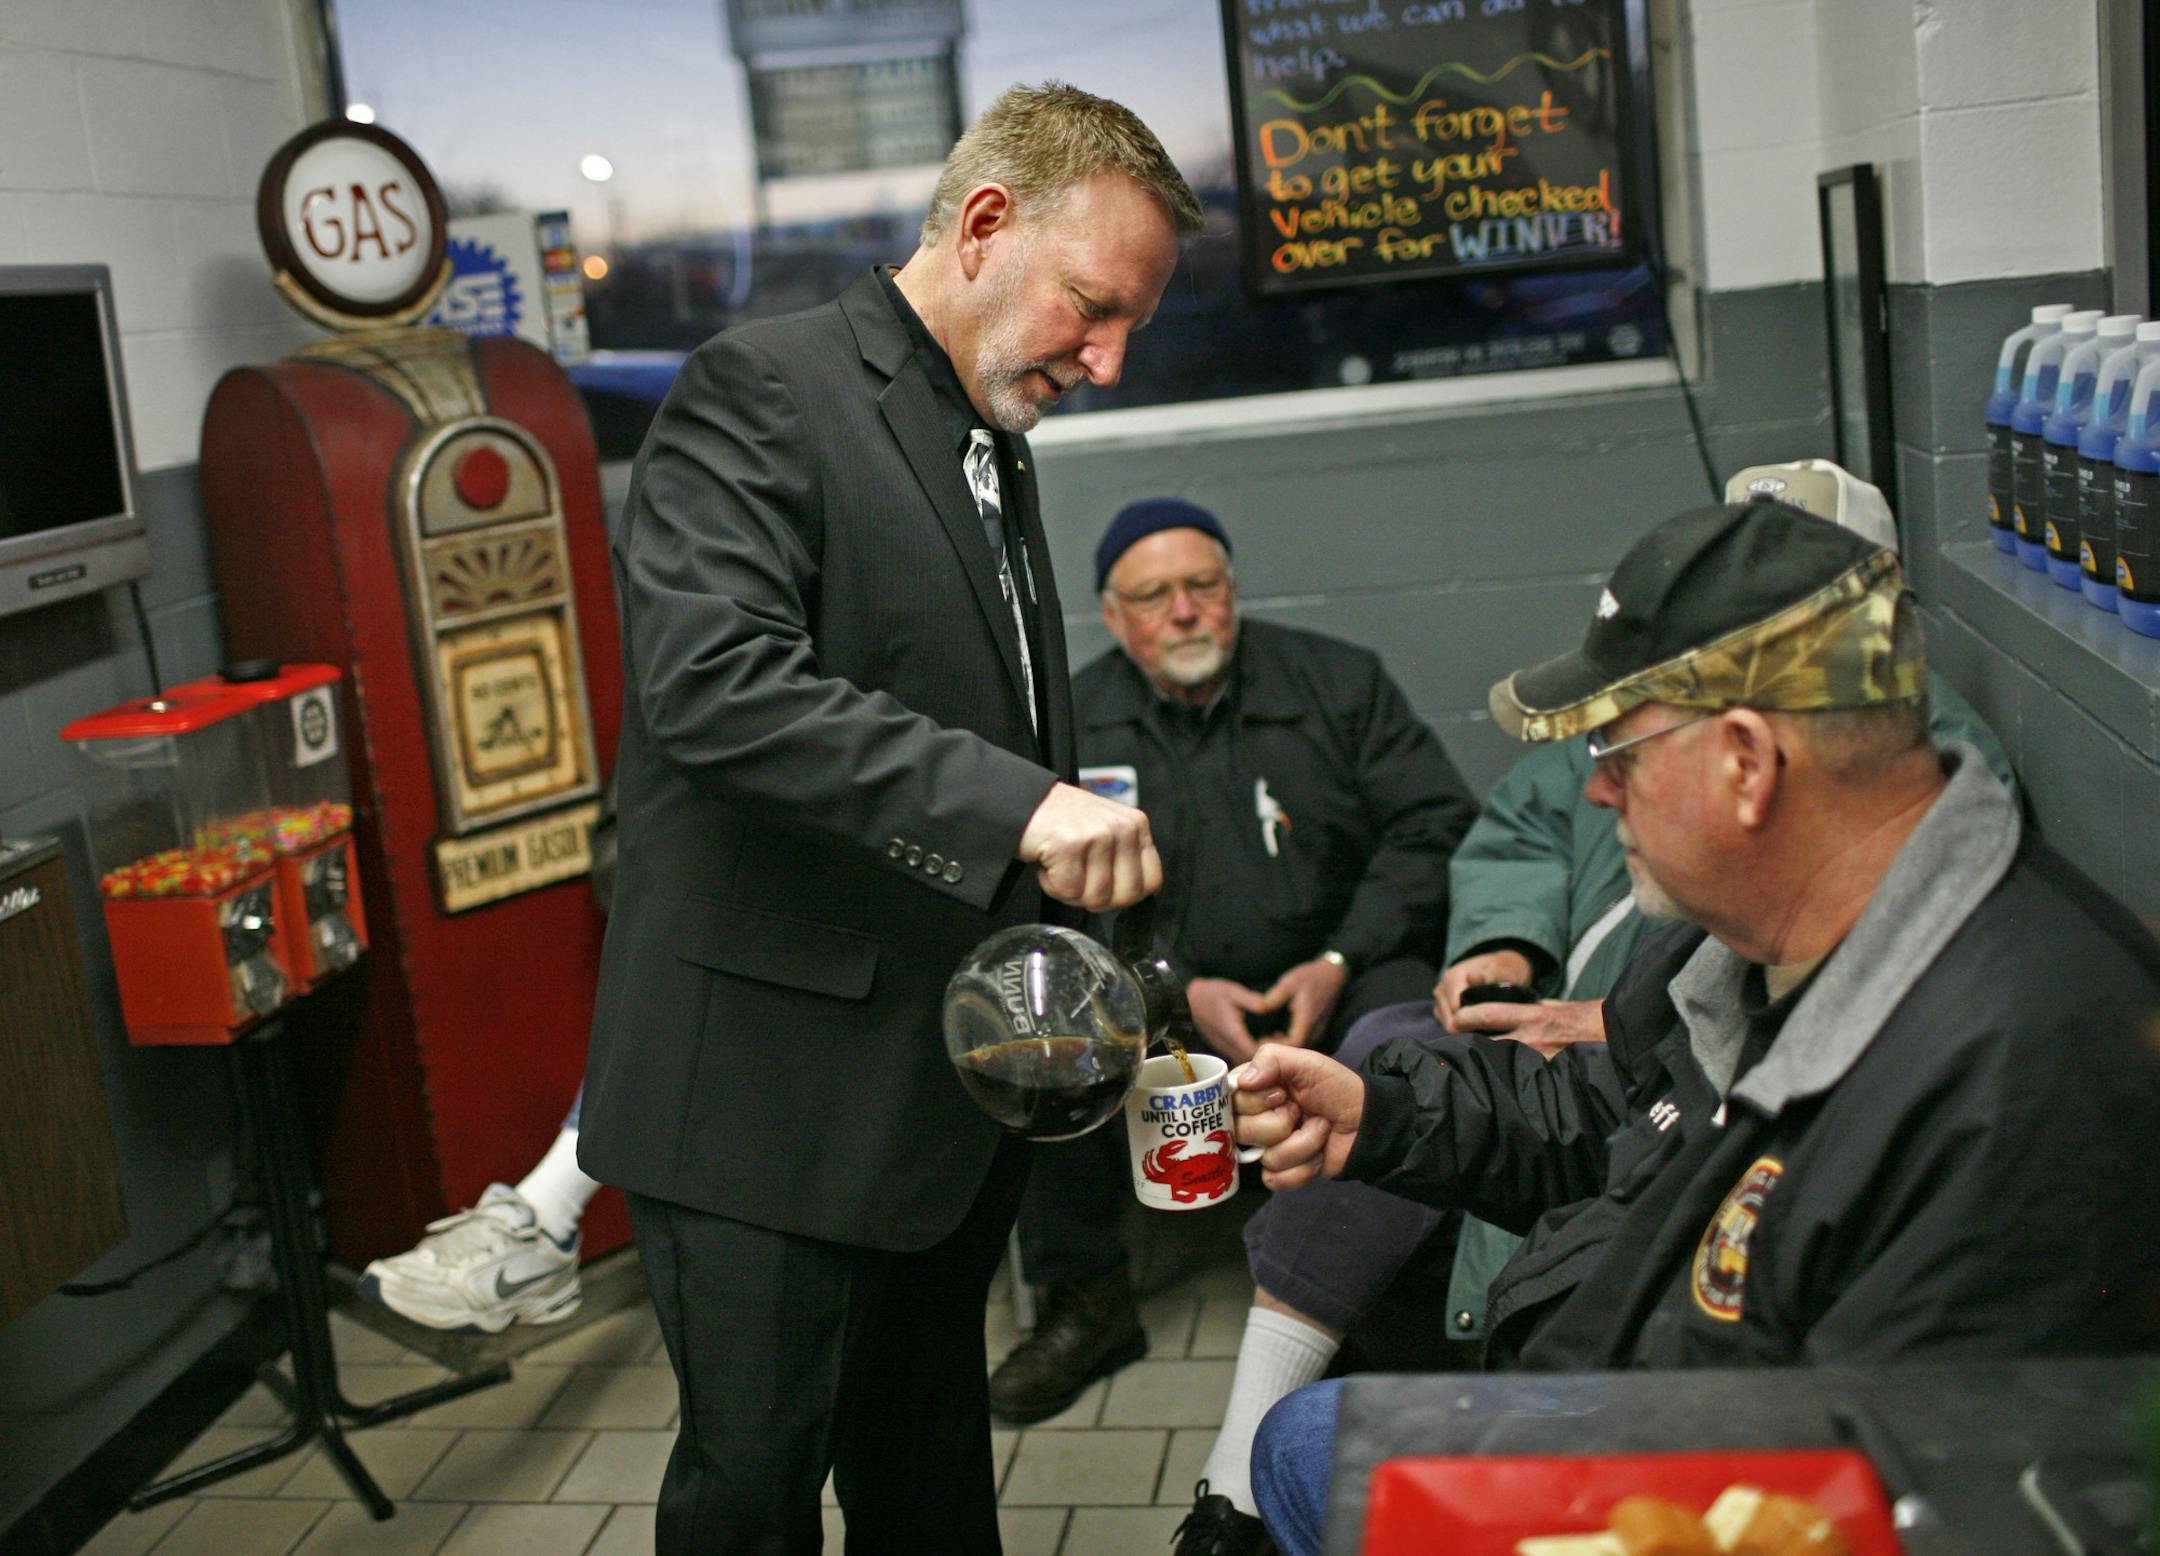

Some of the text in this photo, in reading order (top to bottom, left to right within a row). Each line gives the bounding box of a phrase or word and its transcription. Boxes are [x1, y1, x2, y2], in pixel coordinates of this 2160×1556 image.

[1250, 15, 1326, 46] what
[1337, 7, 1392, 34] we
[1402, 0, 1465, 27] can
[1260, 91, 1569, 168] Don't forget
[1265, 146, 1518, 205] to get your
[1446, 169, 1612, 219] checked
[303, 181, 418, 262] GAS
[1272, 236, 1363, 273] over
[1376, 230, 1446, 262] for
[1142, 1109, 1178, 1123] UNTIL
[1182, 1109, 1187, 1120] I
[1191, 1103, 1216, 1119] GET
[1149, 1083, 1222, 1111] CRABBY
[1161, 1113, 1223, 1139] COFFEE
